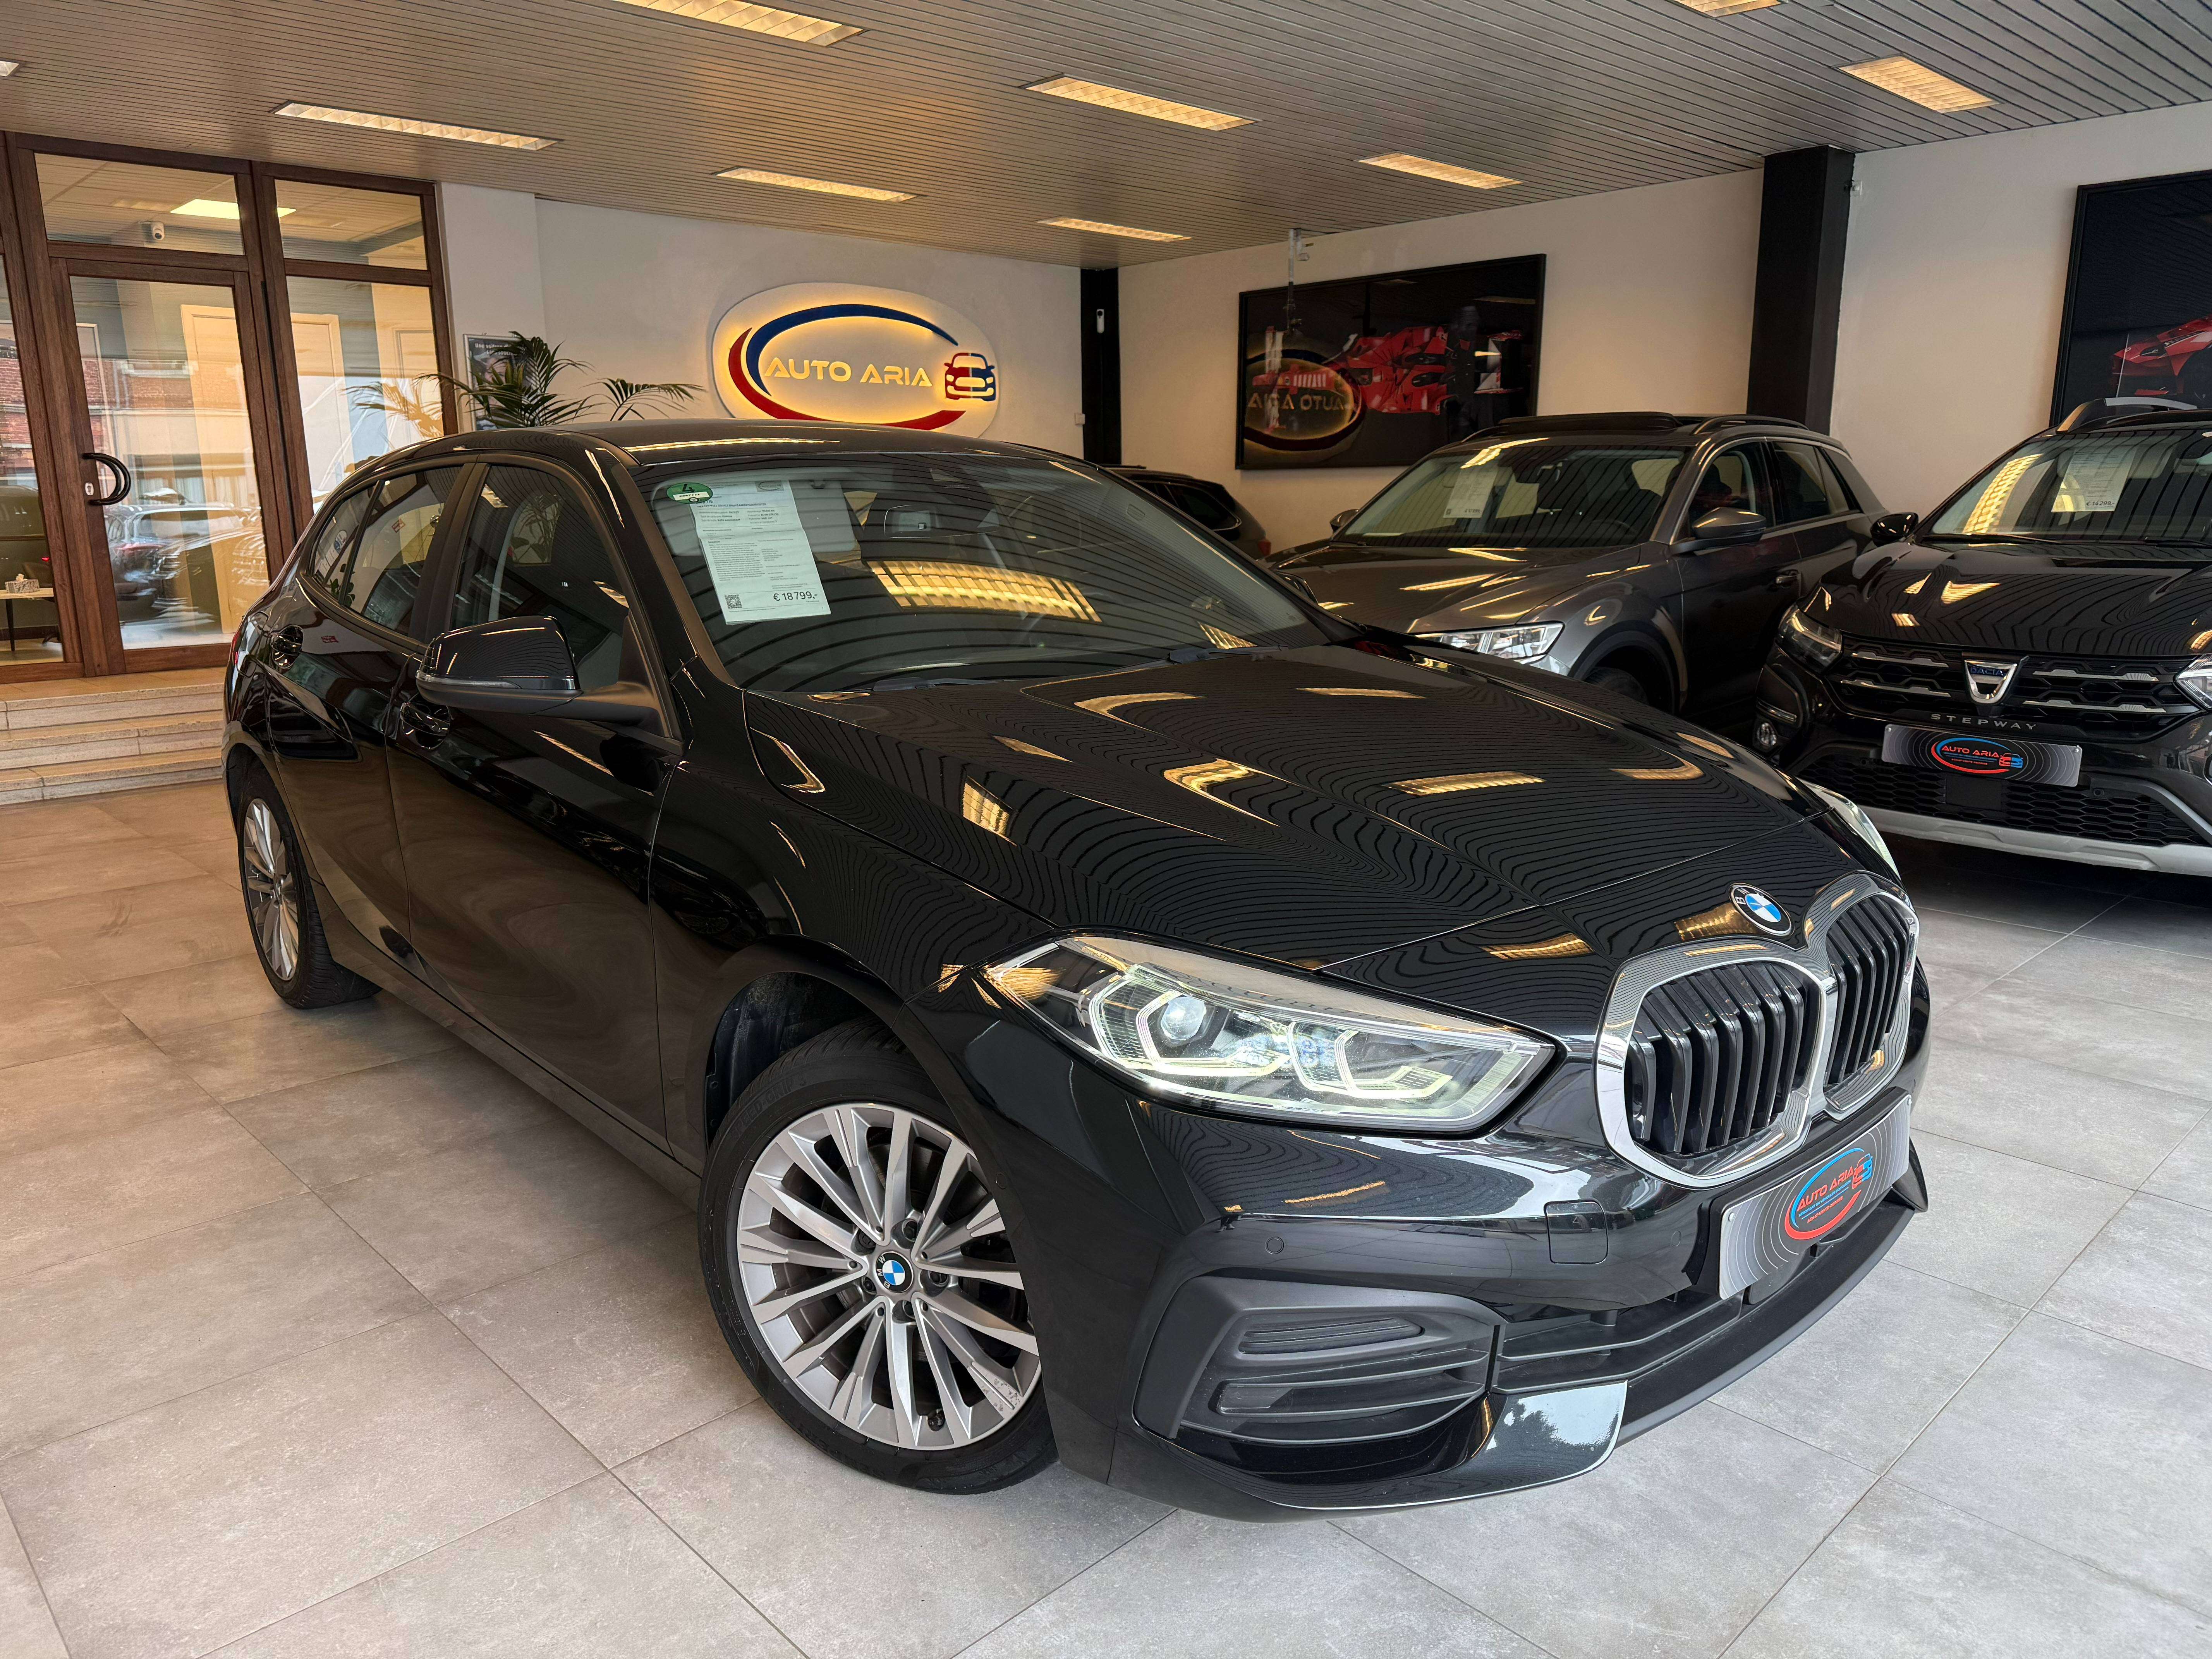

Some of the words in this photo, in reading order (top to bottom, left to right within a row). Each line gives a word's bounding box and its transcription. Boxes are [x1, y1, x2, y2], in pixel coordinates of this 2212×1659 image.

[764, 357, 852, 382] AUTO
[859, 363, 933, 387] ARIA
[682, 483, 696, 493] 4
[773, 593, 780, 601] €
[1970, 666, 2004, 676] DACIA
[1930, 714, 2037, 730] STEPWAY
[1942, 745, 1970, 754] AUTO
[1972, 749, 2000, 758] ARIA
[1797, 1184, 1828, 1211] AUTO
[1829, 1166, 1854, 1191] ARIA
[876, 1255, 891, 1289] BMW
